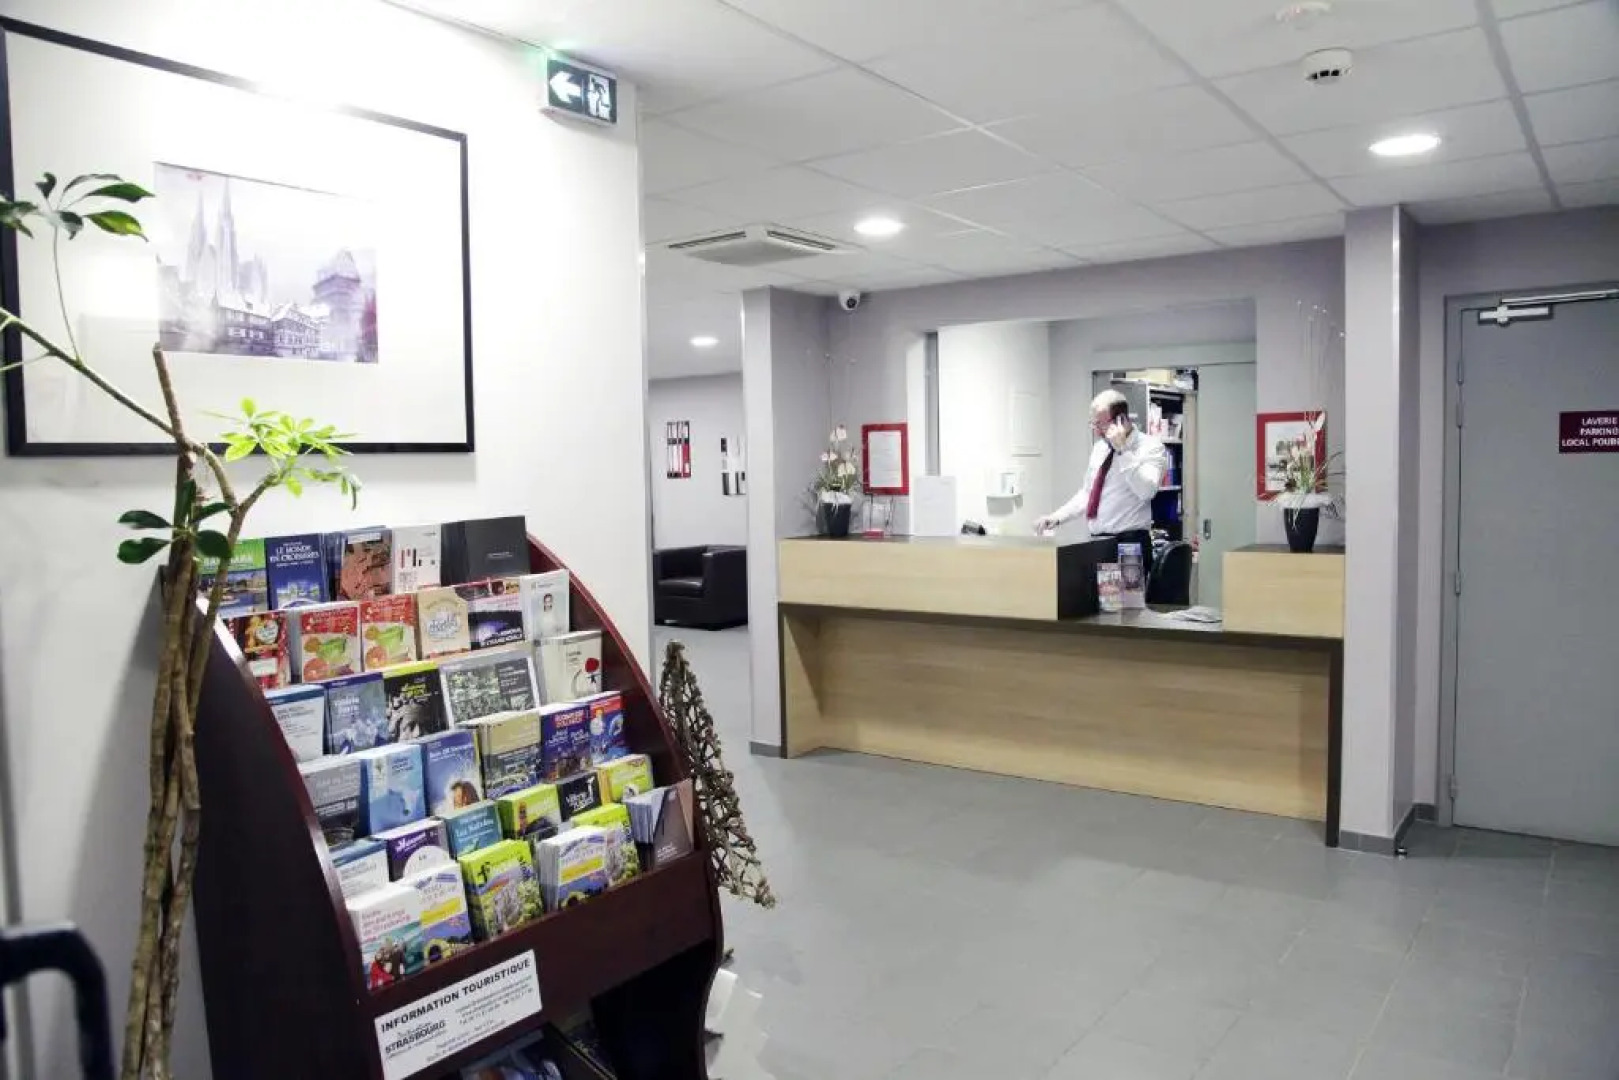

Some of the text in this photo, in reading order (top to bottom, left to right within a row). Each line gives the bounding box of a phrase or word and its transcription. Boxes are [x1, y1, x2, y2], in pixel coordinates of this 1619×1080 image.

[1582, 416, 1617, 425] LAVERIE
[1580, 427, 1618, 436] PARKING
[1561, 438, 1590, 447] LOCAL
[380, 989, 460, 1033] INFORMATION
[462, 958, 531, 996] TOURISTIQUE
[385, 1020, 446, 1054] STRASBOURG
